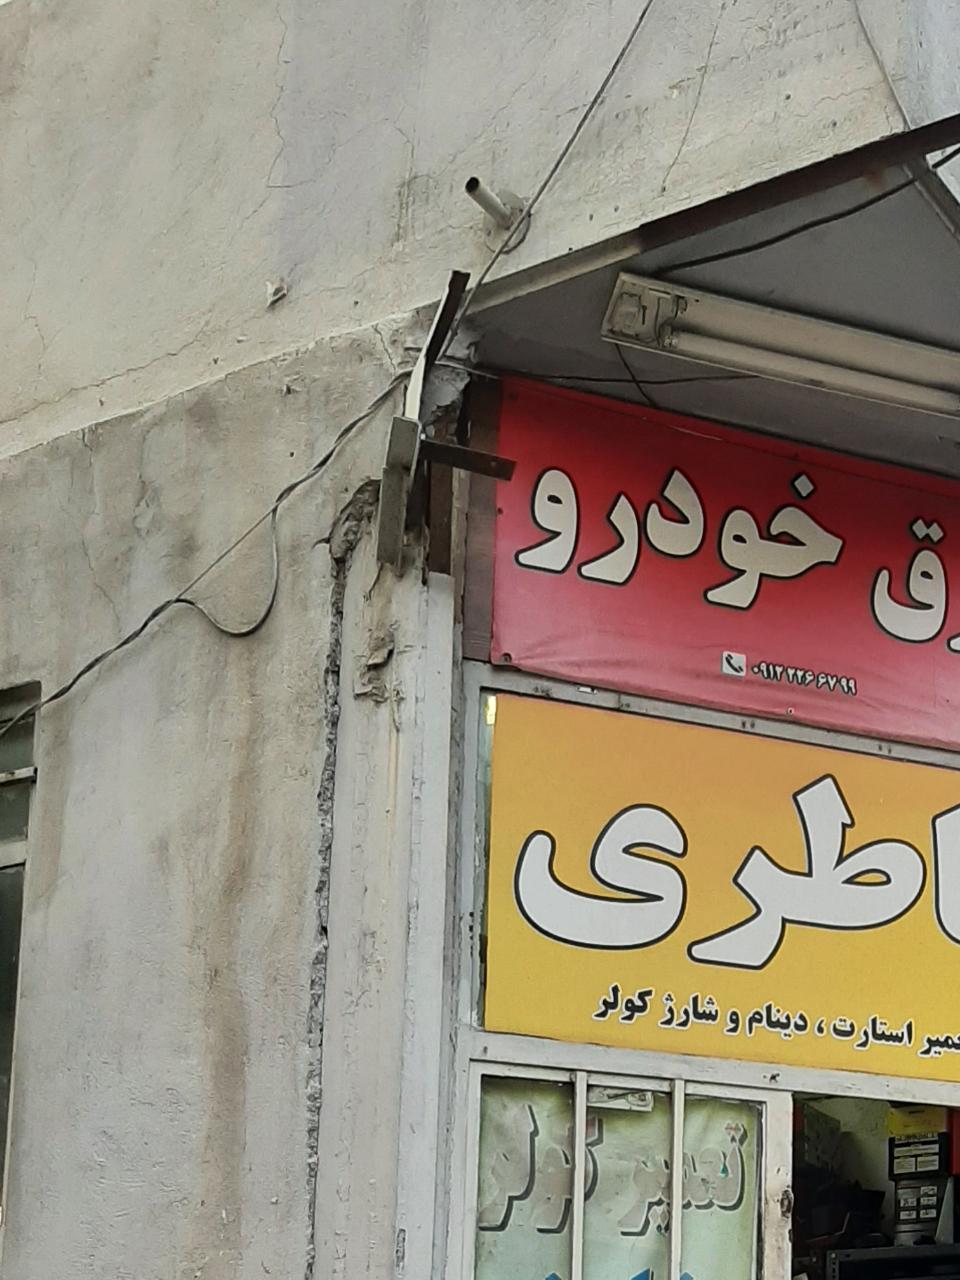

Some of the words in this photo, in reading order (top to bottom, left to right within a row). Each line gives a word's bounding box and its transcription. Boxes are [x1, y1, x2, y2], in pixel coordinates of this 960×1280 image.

[513, 467, 844, 610] خودرو
[839, 676, 857, 696] ۹۹
[593, 983, 654, 1021] کولر
[659, 993, 719, 1028] شارژ
[724, 1009, 741, 1034] و
[747, 1002, 808, 1039] دینام
